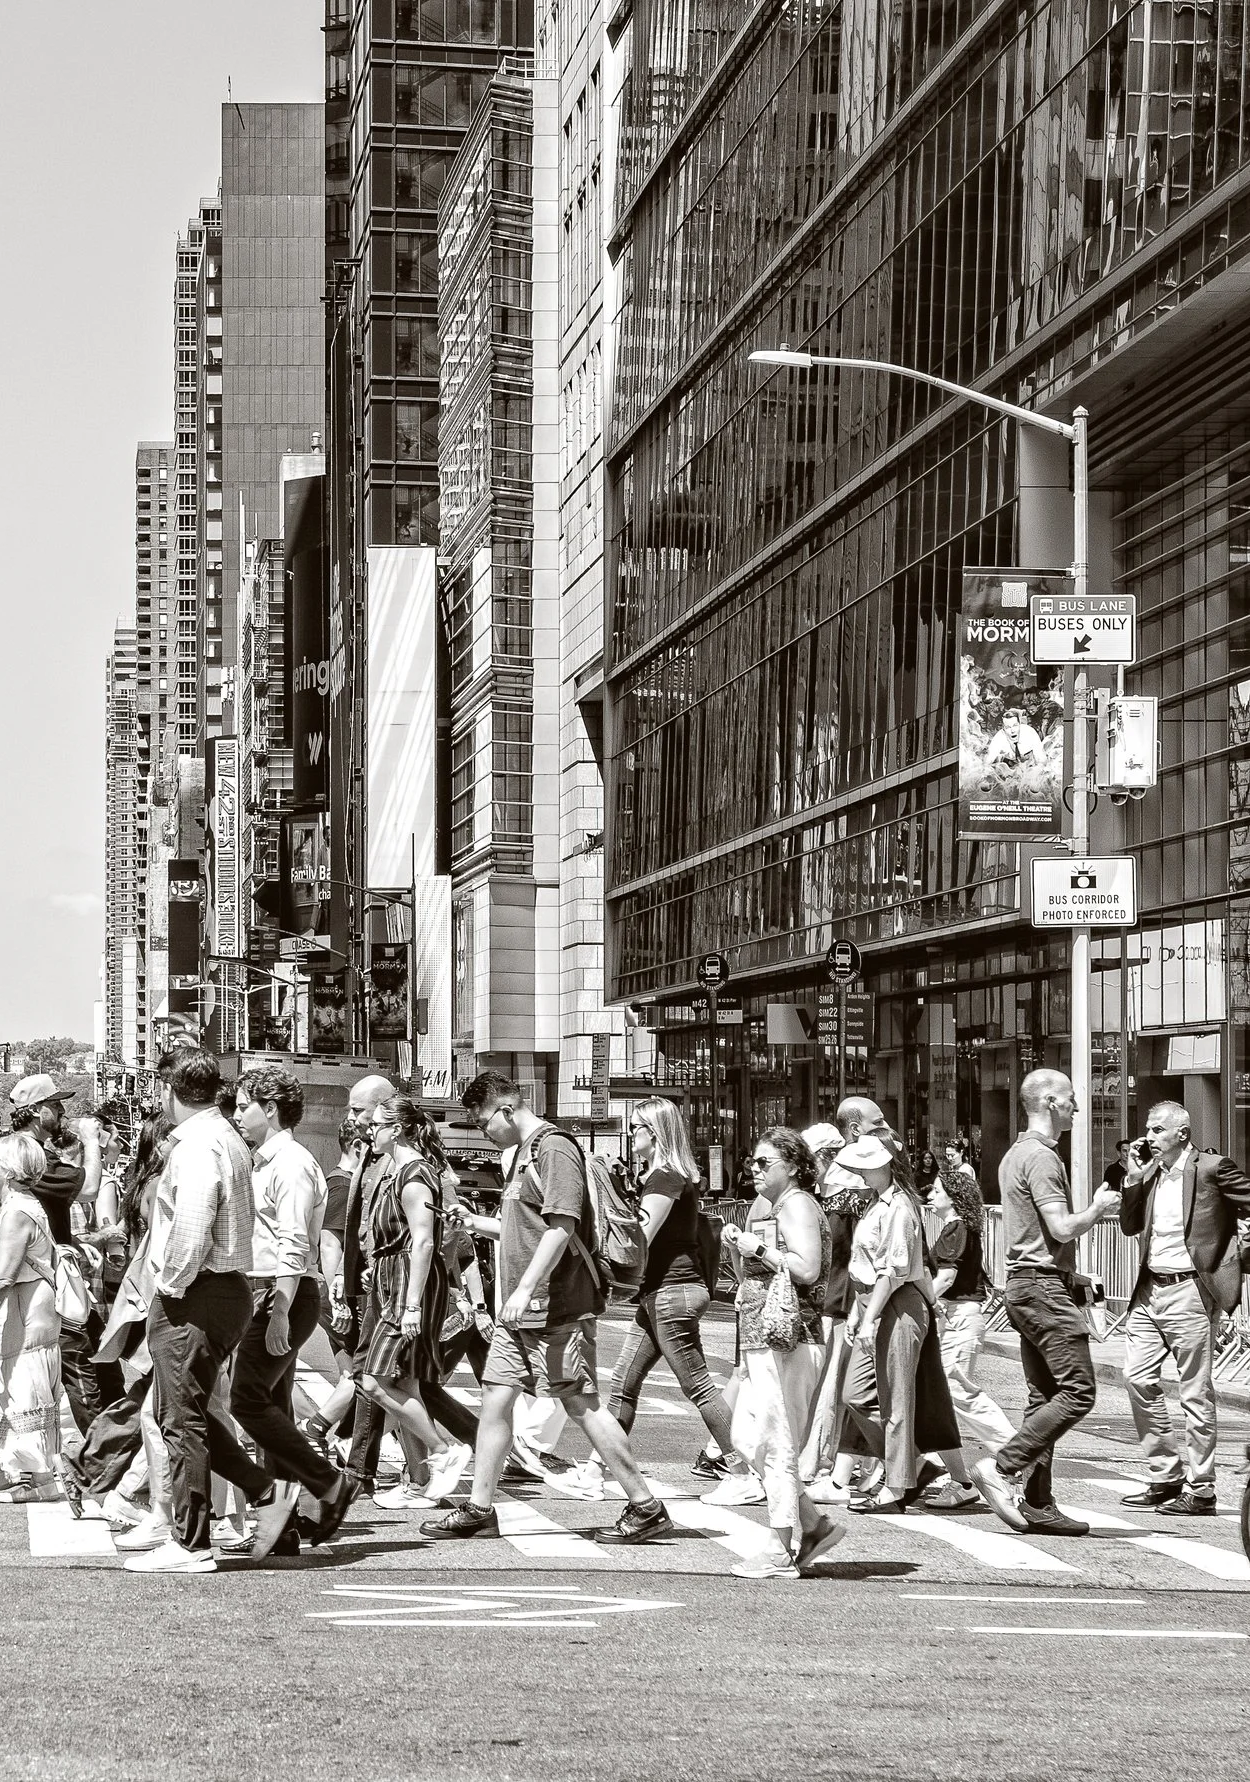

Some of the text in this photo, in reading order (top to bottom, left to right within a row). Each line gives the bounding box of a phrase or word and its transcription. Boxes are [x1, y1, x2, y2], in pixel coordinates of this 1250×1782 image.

[1059, 600, 1127, 611] BUS LANE
[968, 619, 1030, 627] THE BOOK OF
[1038, 617, 1127, 630] BUSES ONLY
[967, 626, 1029, 642] MORM
[217, 743, 236, 776] NEW
[217, 779, 236, 816] 42
[217, 838, 236, 904] STUDIOS
[291, 866, 317, 886] Family
[1049, 895, 1119, 905] BUS CORRIDOR
[1043, 910, 1126, 920] PHOTO ENFORCED
[829, 970, 857, 984] NO STANDING
[699, 980, 707, 988] NO
[692, 998, 707, 1007] M42
[819, 994, 834, 1004] SIM8
[819, 1008, 838, 1017] SIM22
[818, 1021, 838, 1031] SIM30
